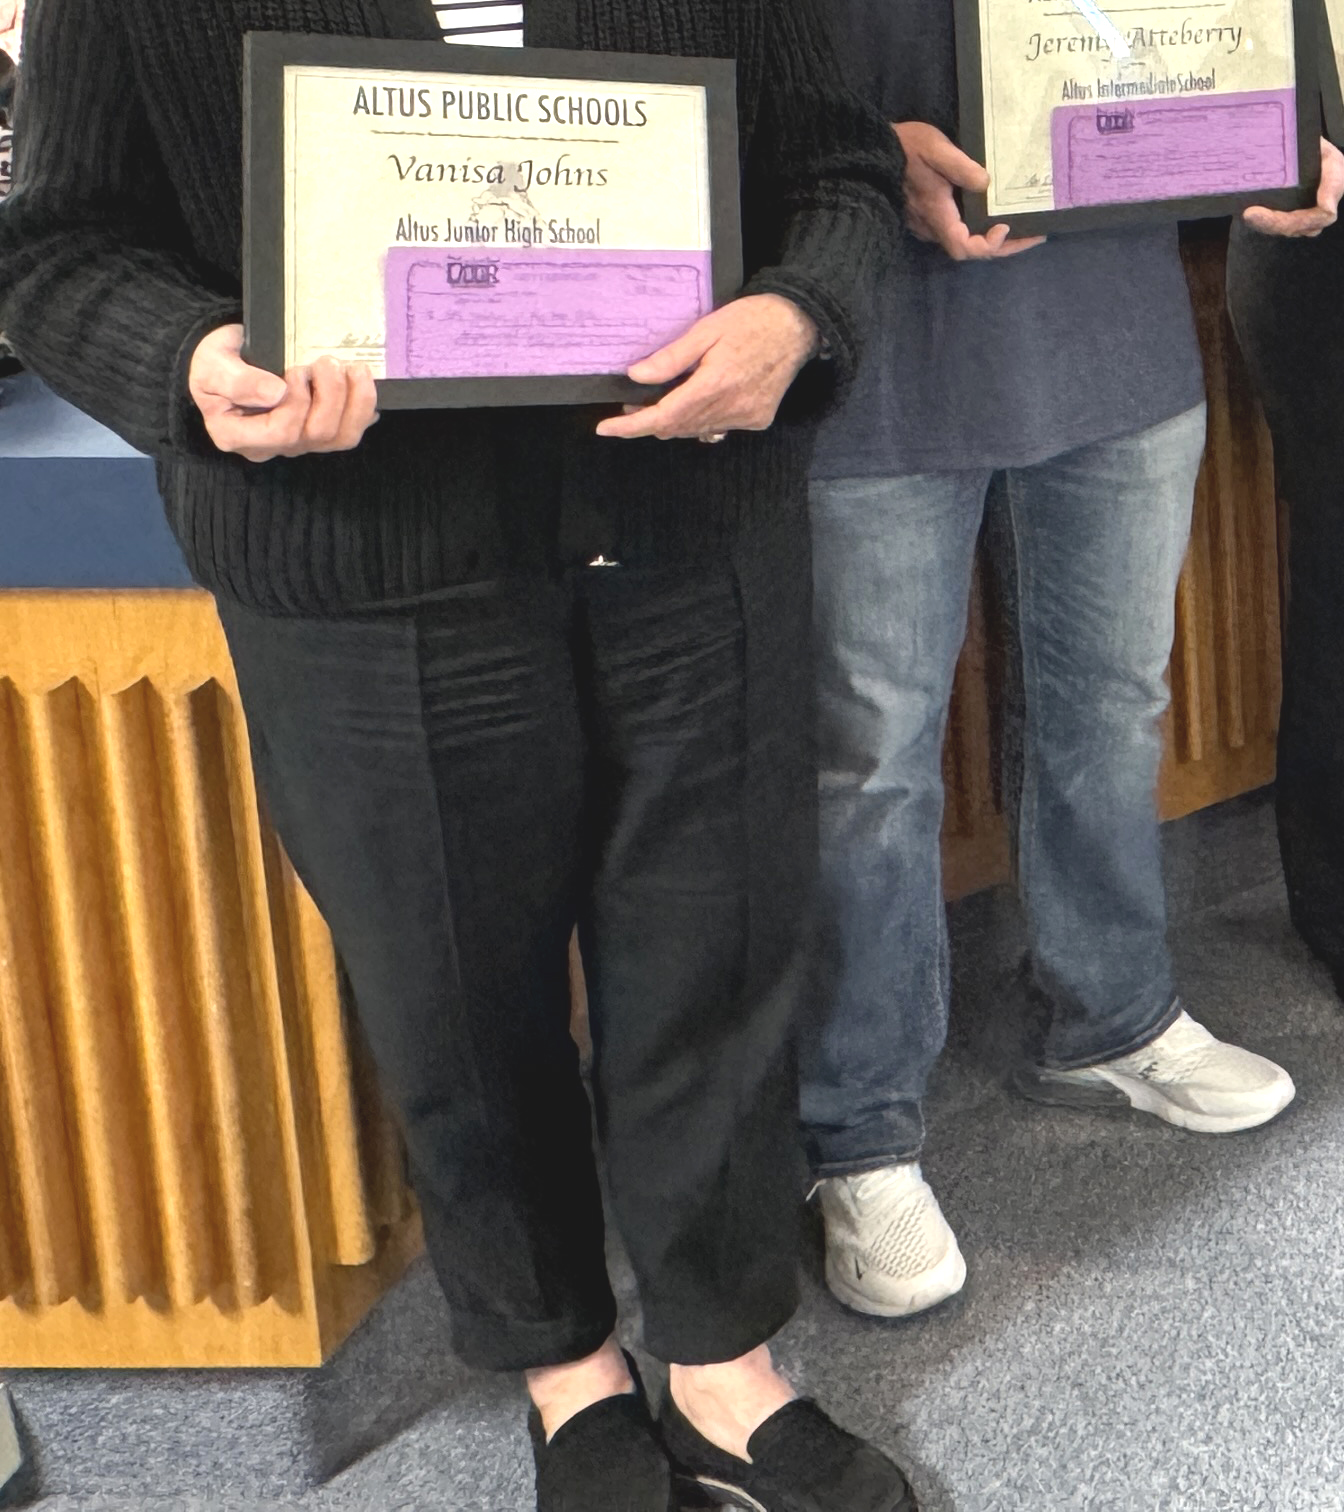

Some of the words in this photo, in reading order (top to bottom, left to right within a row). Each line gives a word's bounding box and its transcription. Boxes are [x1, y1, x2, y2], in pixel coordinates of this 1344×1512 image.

[1177, 67, 1216, 92] School
[352, 85, 432, 119] ALTUS
[442, 90, 530, 123] PUBLIC
[537, 94, 648, 128] SCHOOLS
[387, 154, 506, 185] Vanisa
[513, 153, 609, 193] Johns
[395, 213, 439, 243] Altus
[443, 218, 499, 245] Junior
[504, 218, 544, 249] High
[547, 217, 602, 246] School
